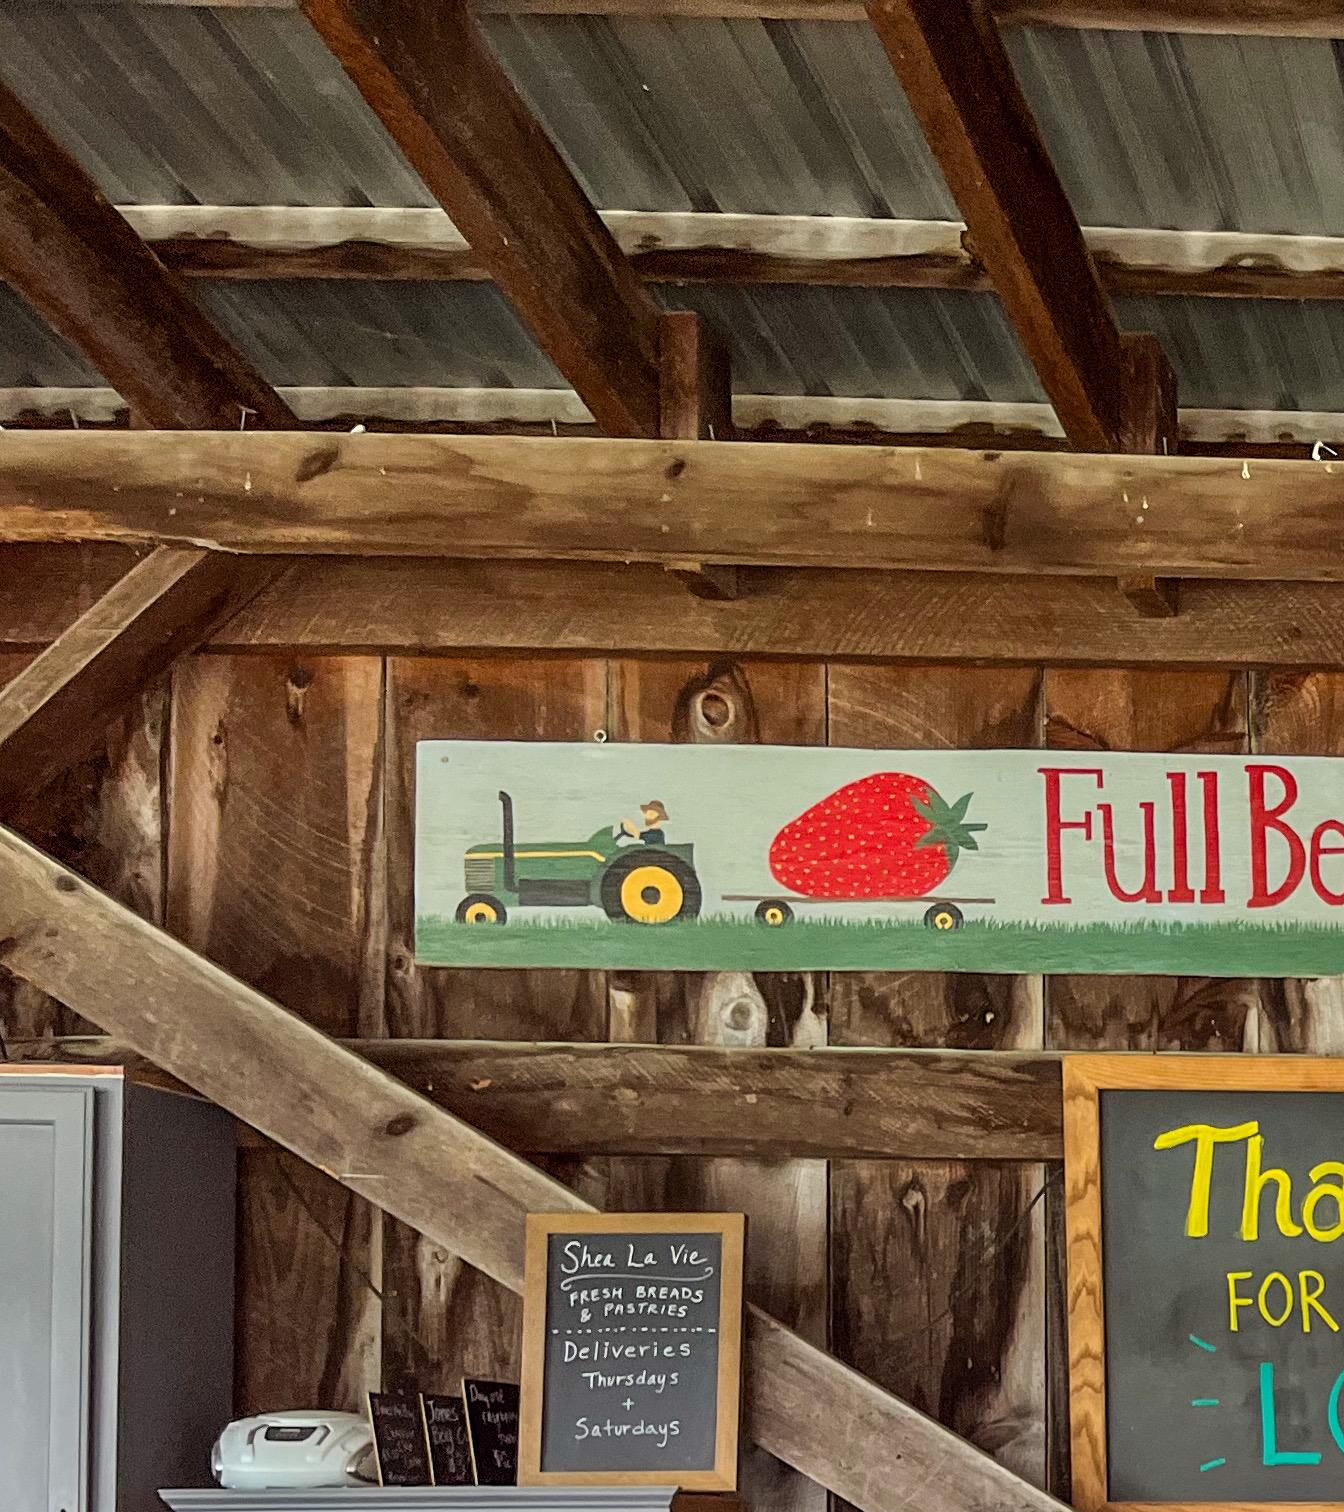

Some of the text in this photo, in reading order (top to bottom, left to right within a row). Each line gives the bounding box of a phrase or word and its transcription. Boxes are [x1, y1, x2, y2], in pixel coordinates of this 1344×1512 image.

[1038, 767, 1224, 904] Full
[561, 1241, 708, 1273] Shea La Vie
[570, 1286, 703, 1307] FRESH BREADS
[1227, 1270, 1340, 1332] FOR
[580, 1303, 688, 1323] & PASTRIES
[564, 1341, 690, 1362] Deliveries
[582, 1370, 679, 1393] Thursdays
[622, 1398, 634, 1410] +
[575, 1417, 680, 1447] Saturdays
